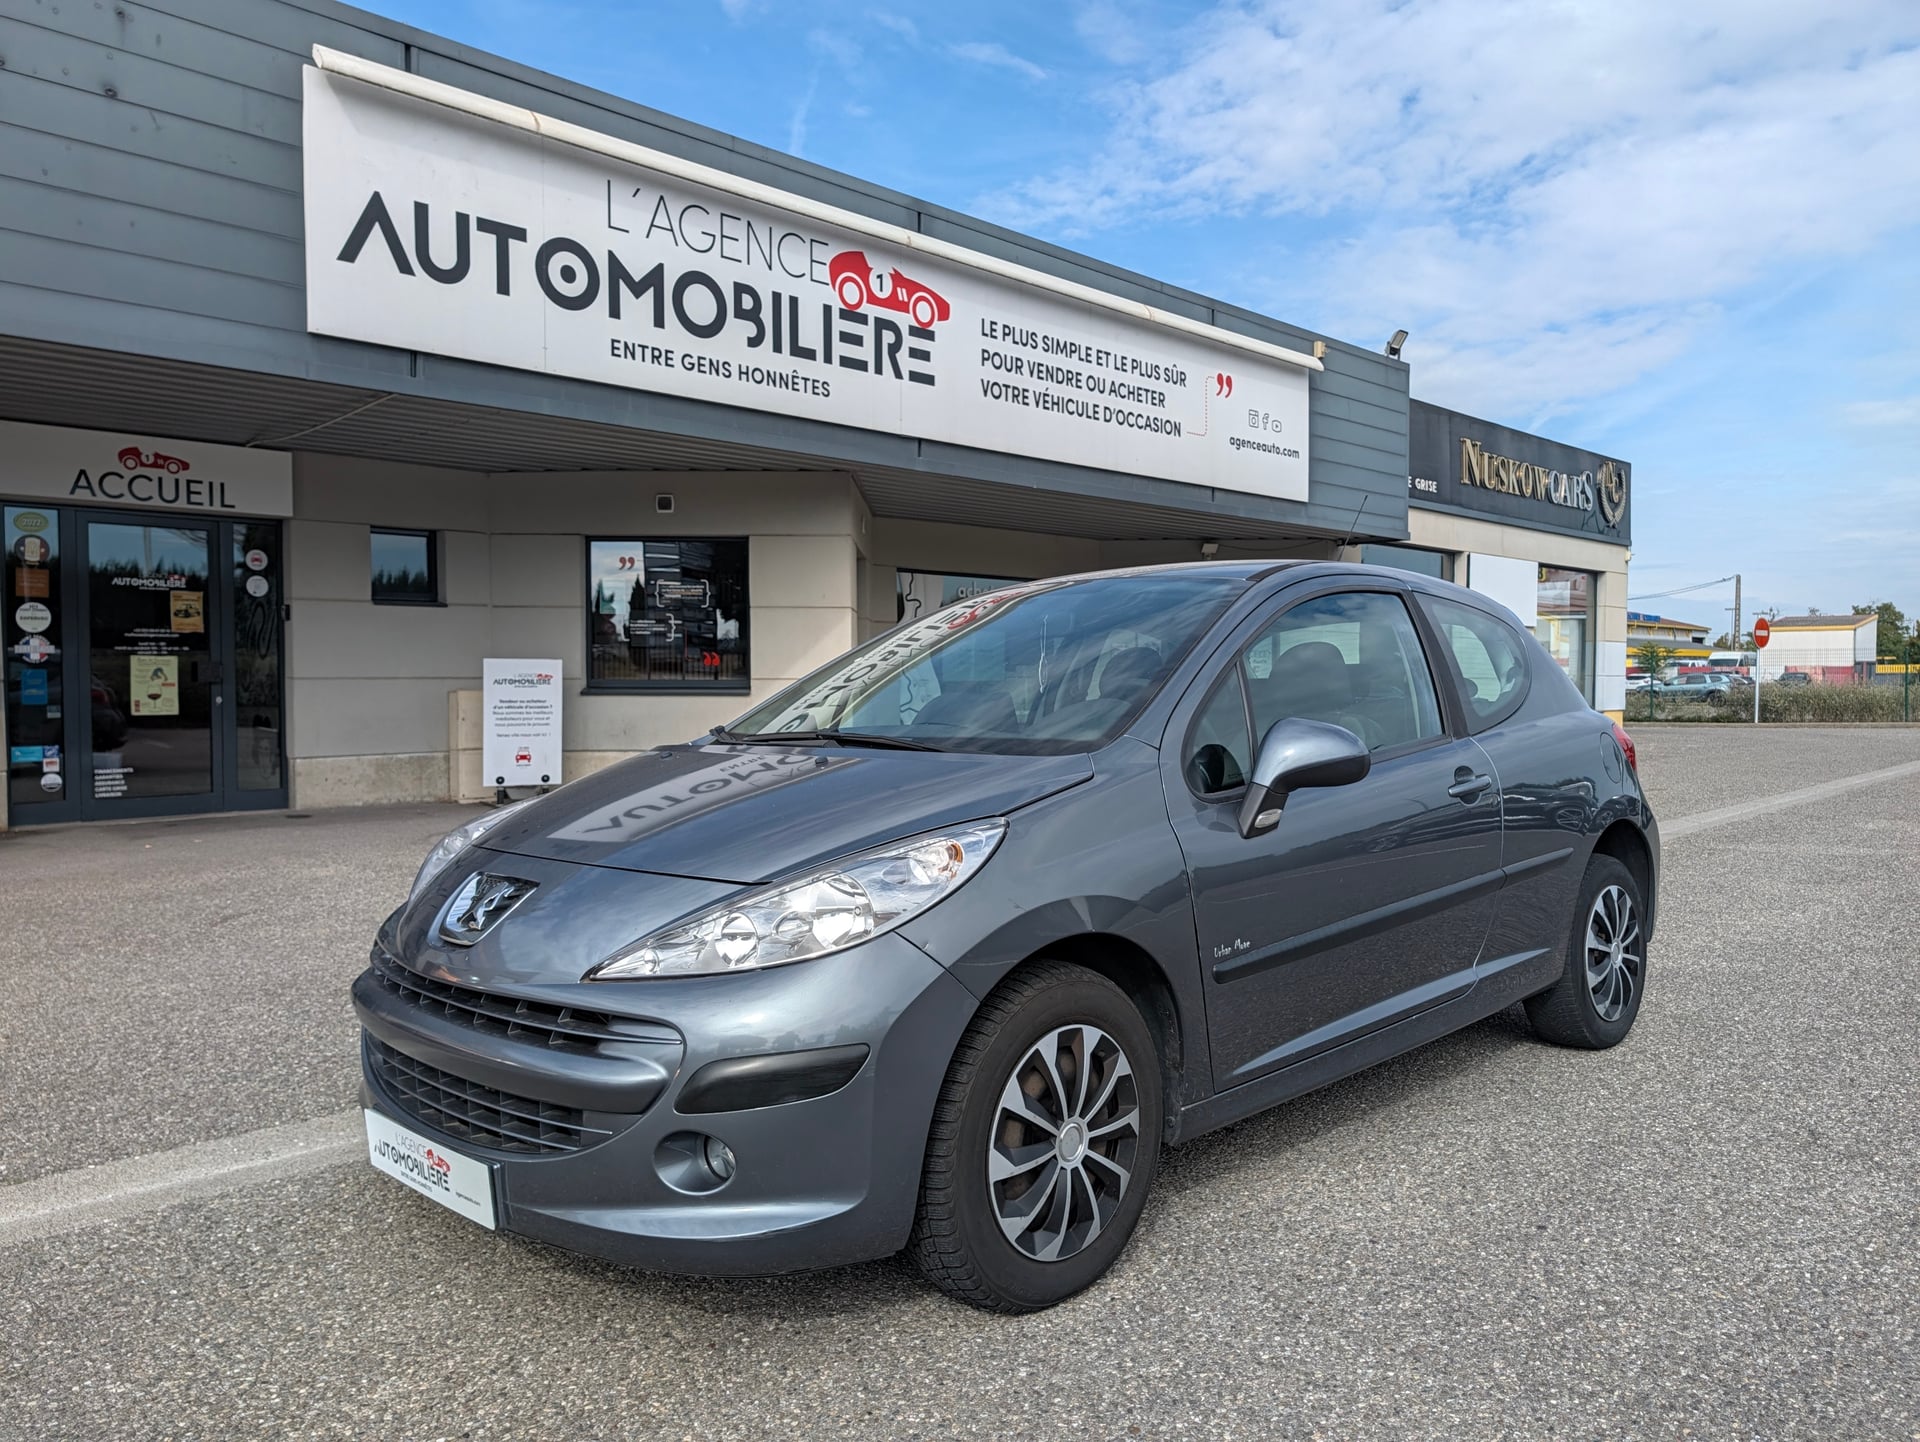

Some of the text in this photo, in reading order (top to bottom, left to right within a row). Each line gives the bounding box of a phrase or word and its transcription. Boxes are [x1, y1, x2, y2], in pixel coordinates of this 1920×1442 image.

[607, 179, 830, 286] L'AGENCE
[610, 338, 832, 399] ENTRE GENS HONNÊTES
[981, 318, 1188, 389] LE PLUS SIMPLE ET LE PLUS SÛR
[981, 348, 1166, 410] POUR VENDRE OU ACHETER
[980, 378, 1183, 439] VOTRE VÉHICULE D'OCCASION
[1229, 434, 1301, 461] agenceauto.com
[69, 468, 236, 509] ACCUEIL
[1415, 479, 1438, 494] GRISE
